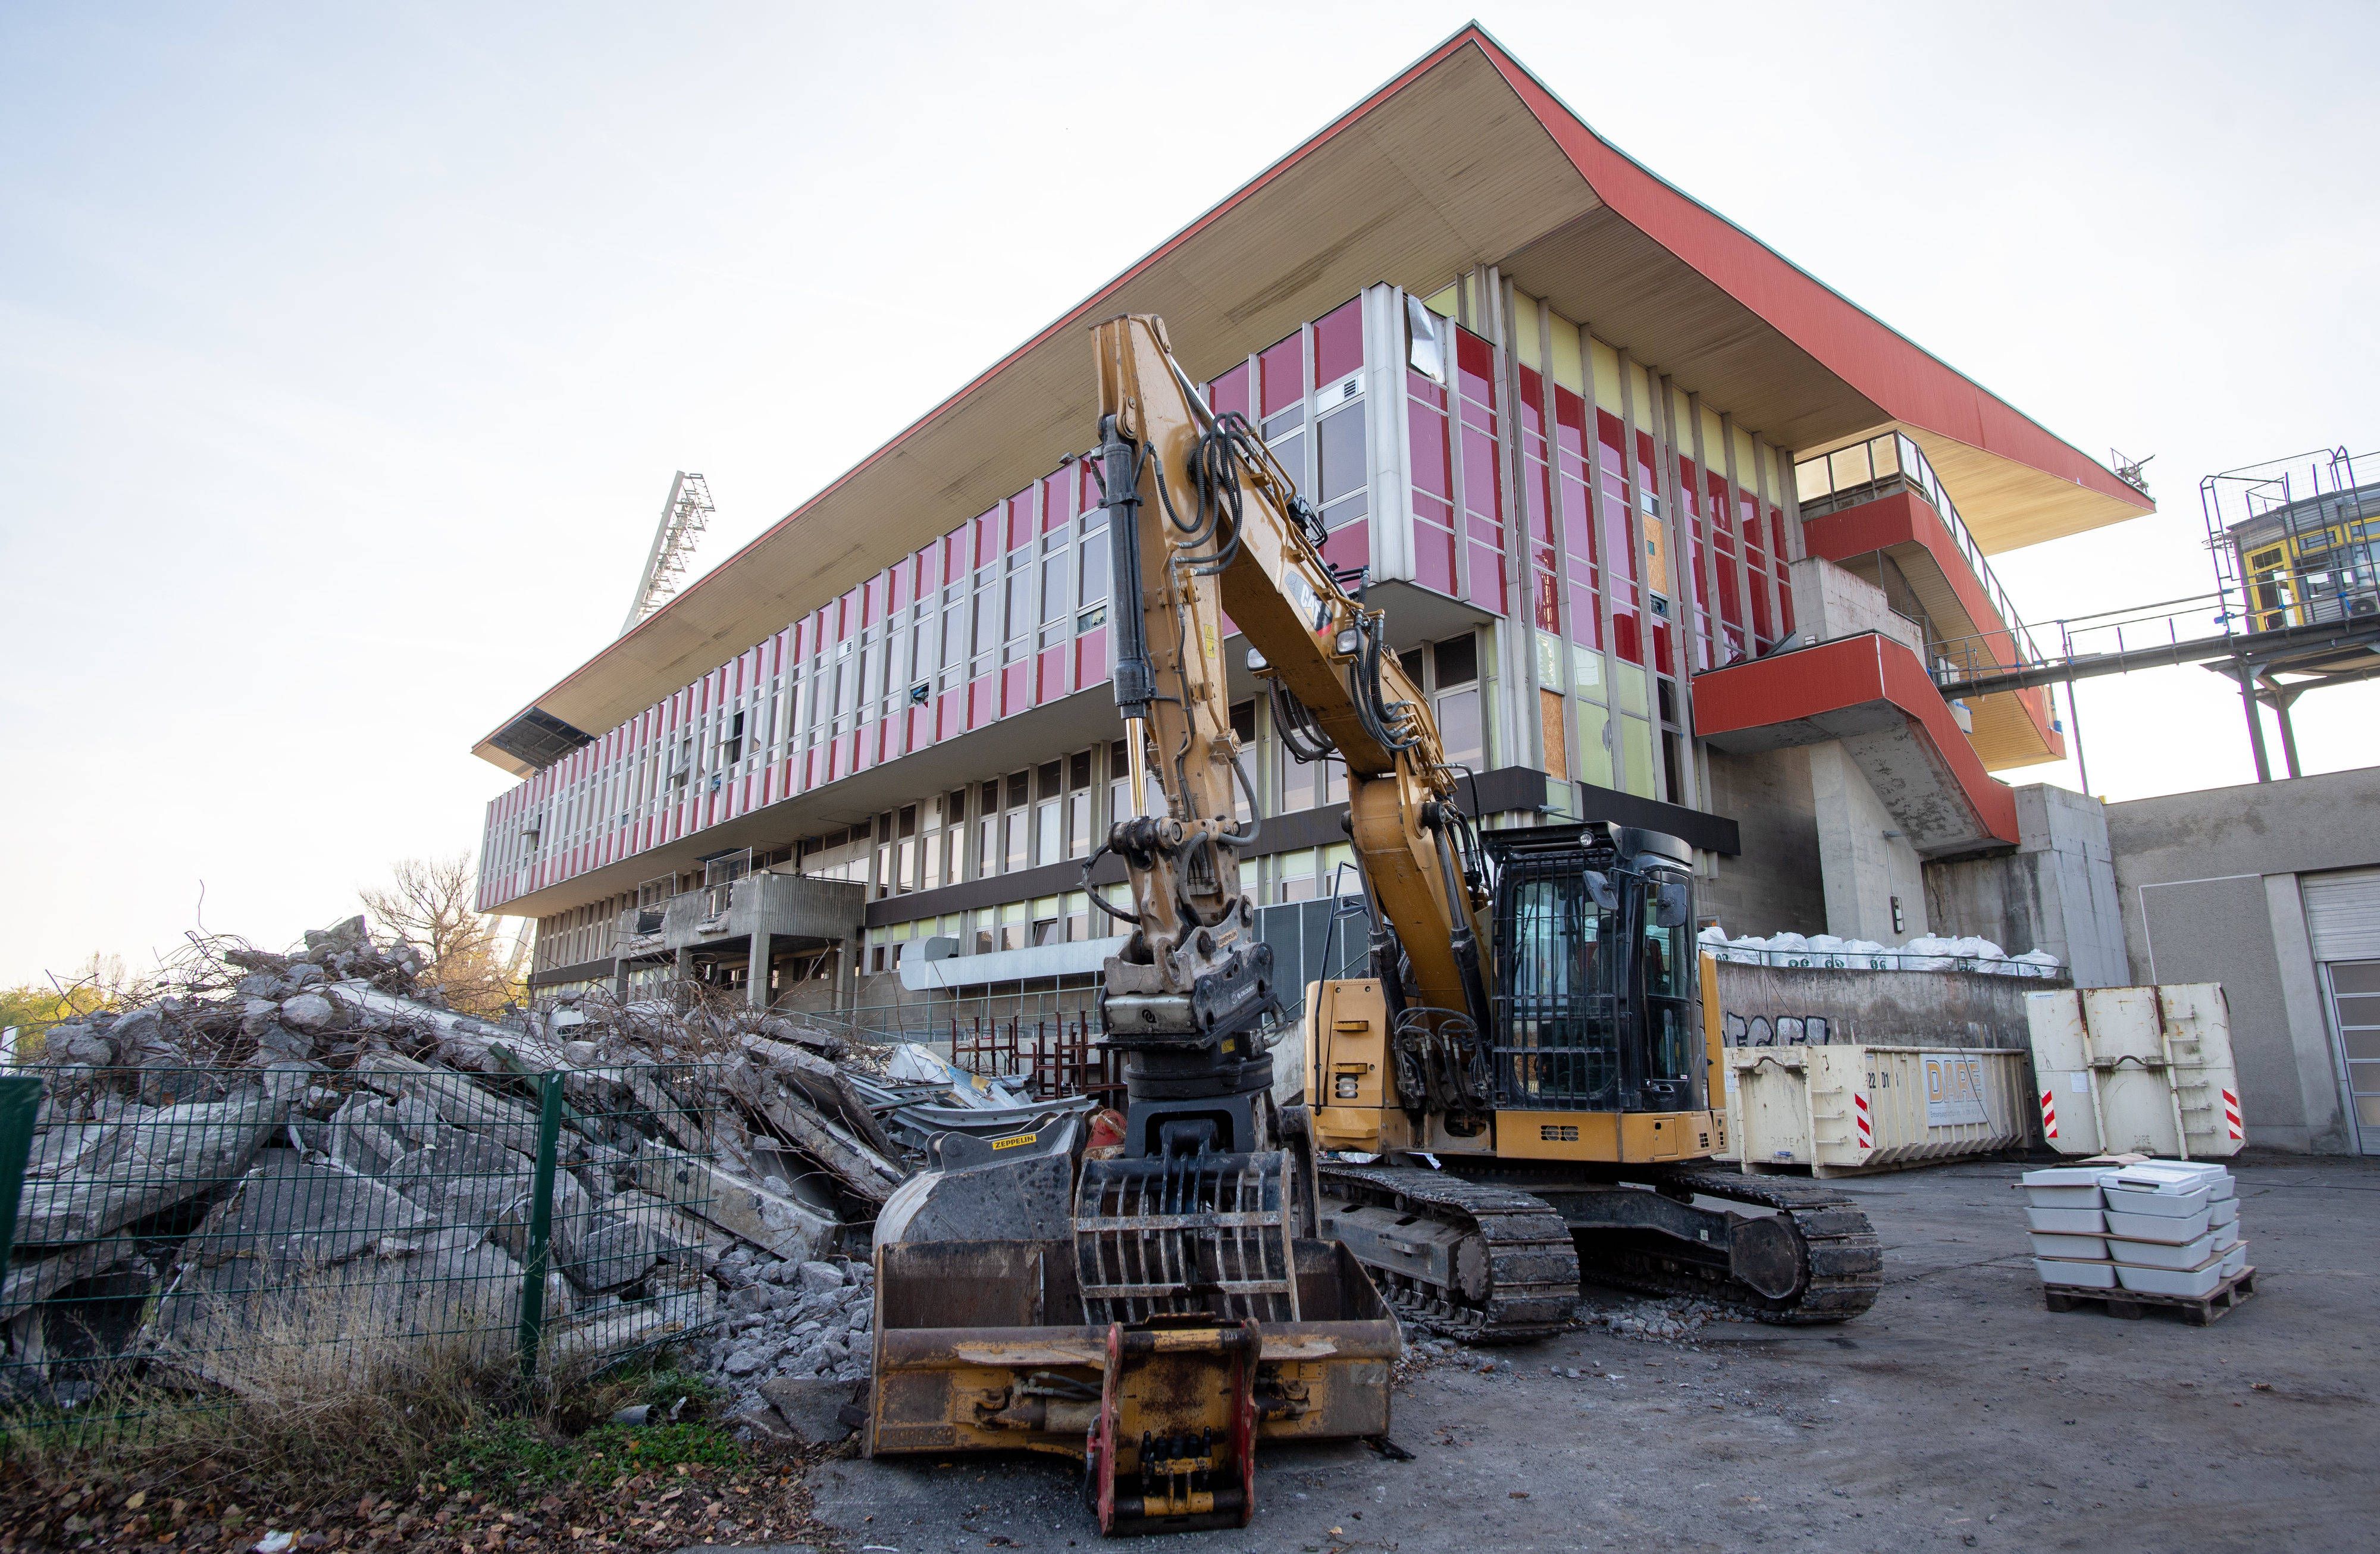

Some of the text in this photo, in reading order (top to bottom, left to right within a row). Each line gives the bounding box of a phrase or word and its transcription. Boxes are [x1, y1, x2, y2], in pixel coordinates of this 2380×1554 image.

[1301, 584, 1321, 628] CAT
[1868, 1072, 1876, 1089] 22
[1926, 1060, 1982, 1104] DARE
[995, 1135, 1034, 1148] ZEPPELIN
